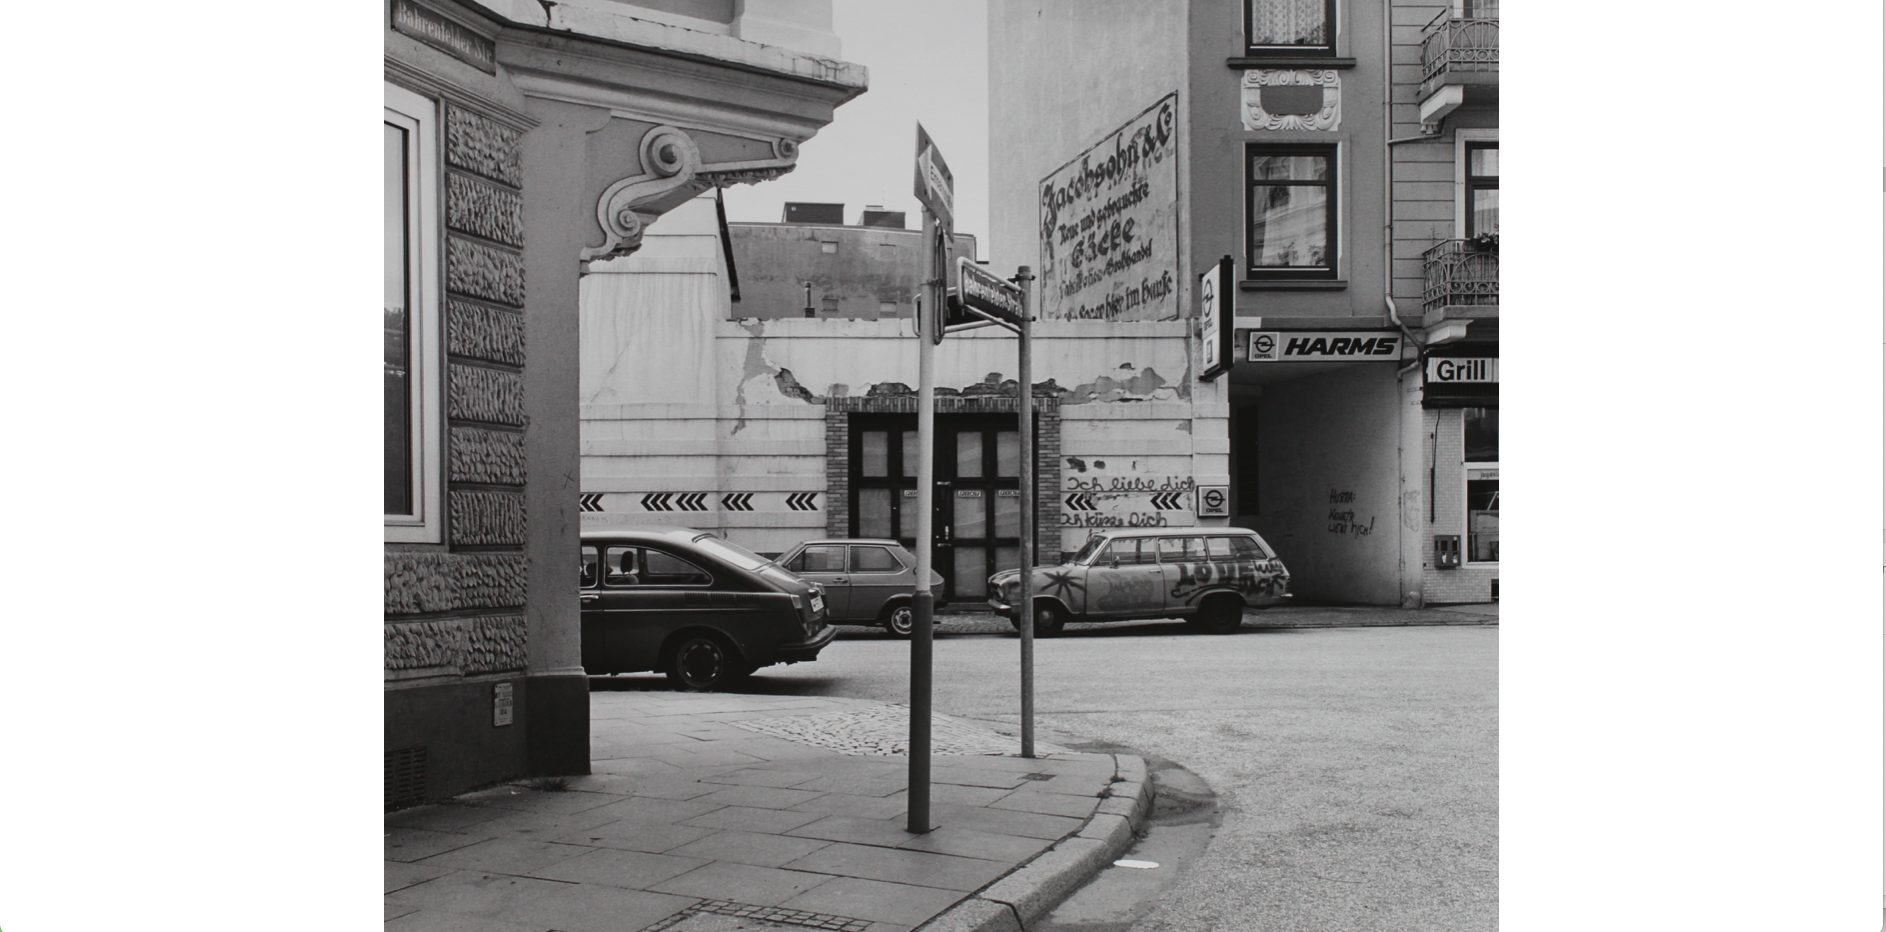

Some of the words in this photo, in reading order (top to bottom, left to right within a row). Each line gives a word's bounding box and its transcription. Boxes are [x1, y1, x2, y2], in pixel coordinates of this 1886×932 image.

[398, 0, 471, 54] Bahrenfelder
[1080, 207, 1096, 233] und
[1284, 337, 1399, 356] HARMS
[1436, 359, 1486, 381] Grill
[1067, 476, 1104, 491] Ich
[1109, 476, 1157, 492] liebe
[1160, 476, 1195, 492] dich
